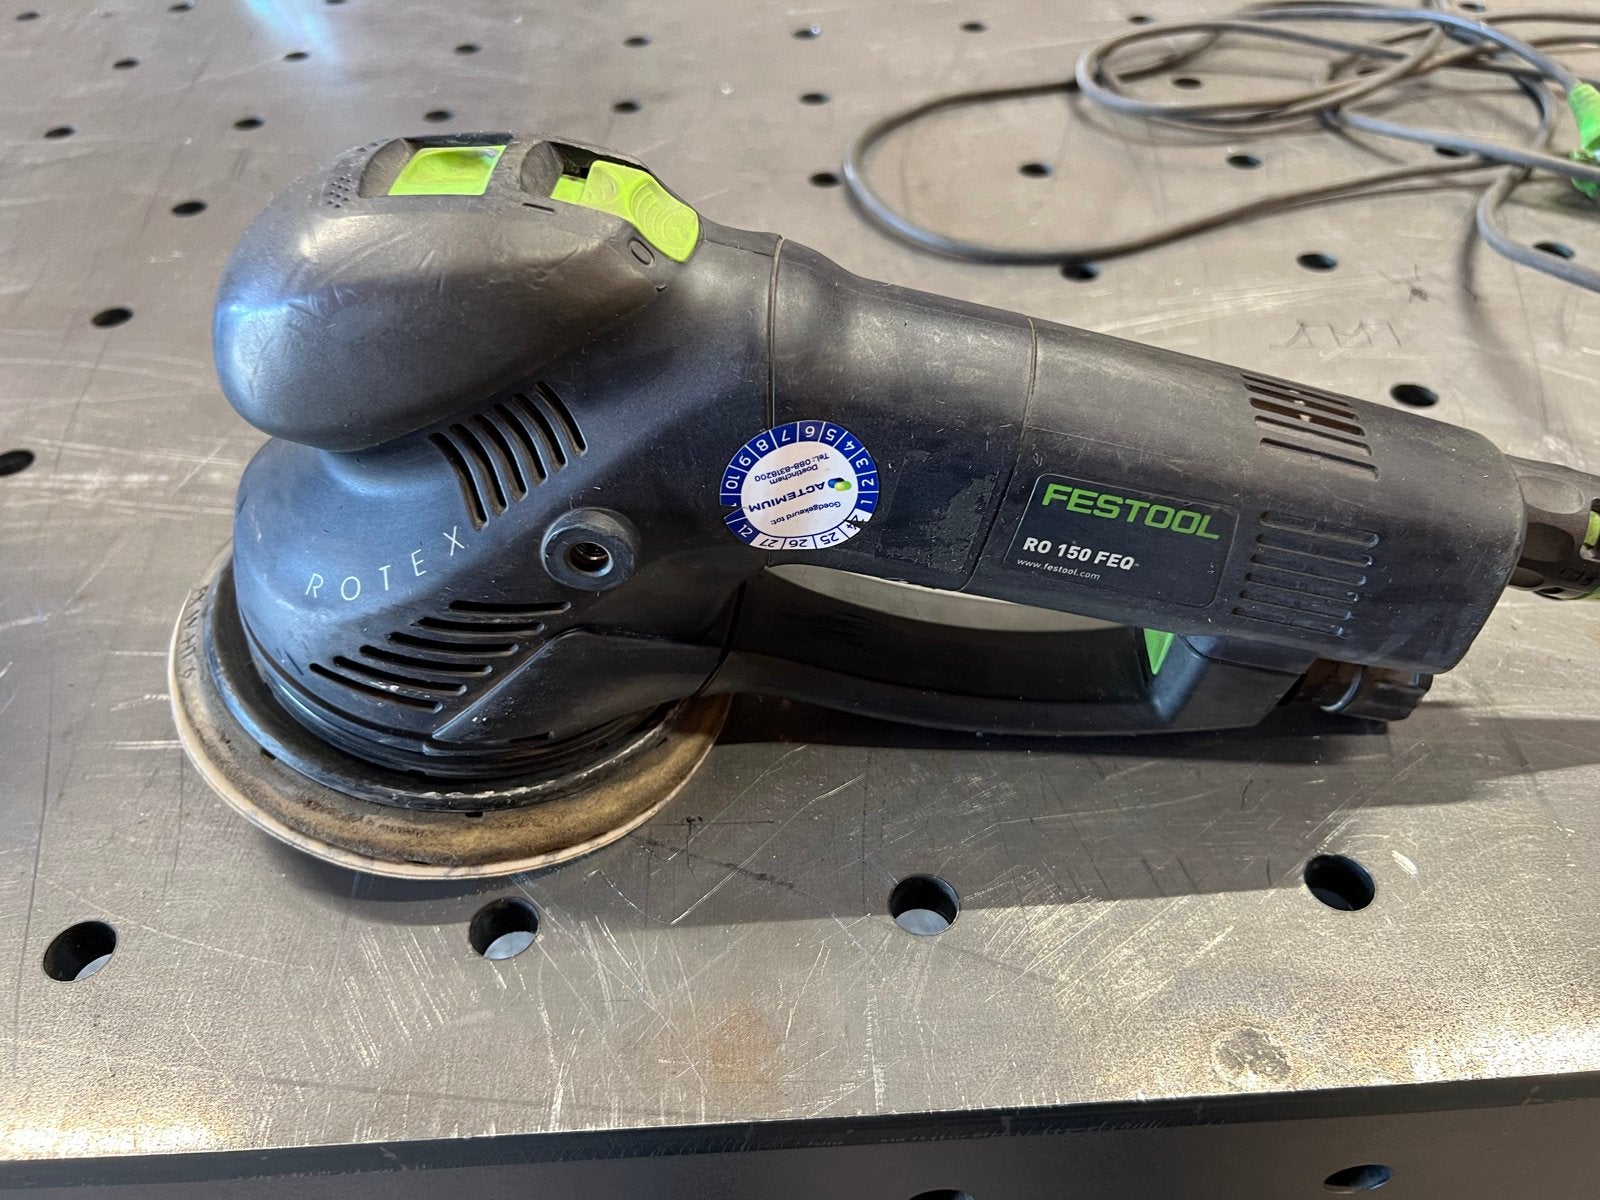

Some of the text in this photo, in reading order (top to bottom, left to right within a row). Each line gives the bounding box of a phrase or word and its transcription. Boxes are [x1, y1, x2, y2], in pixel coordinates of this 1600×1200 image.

[781, 430, 791, 440] 7
[804, 426, 816, 437] 6
[825, 428, 838, 441] 5
[755, 440, 769, 452] 8
[844, 440, 856, 451] 4
[738, 455, 752, 467] 9
[856, 456, 869, 468] 3
[754, 457, 811, 483] 088-8318200
[769, 464, 819, 485] Doetinchem
[725, 475, 741, 489] 10
[862, 477, 875, 487] 2
[747, 481, 826, 513] ACTEMIUM
[769, 500, 842, 526] Goedgekeurd tot:
[1041, 483, 1220, 540] FESTOOL
[737, 523, 753, 537] 12
[759, 537, 779, 548] 27
[788, 538, 808, 548] 26
[819, 531, 840, 545] 25
[1022, 536, 1136, 571] RO 150 FEQ
[305, 525, 465, 601] ROTEX
[1016, 558, 1101, 581] www.festool.com
